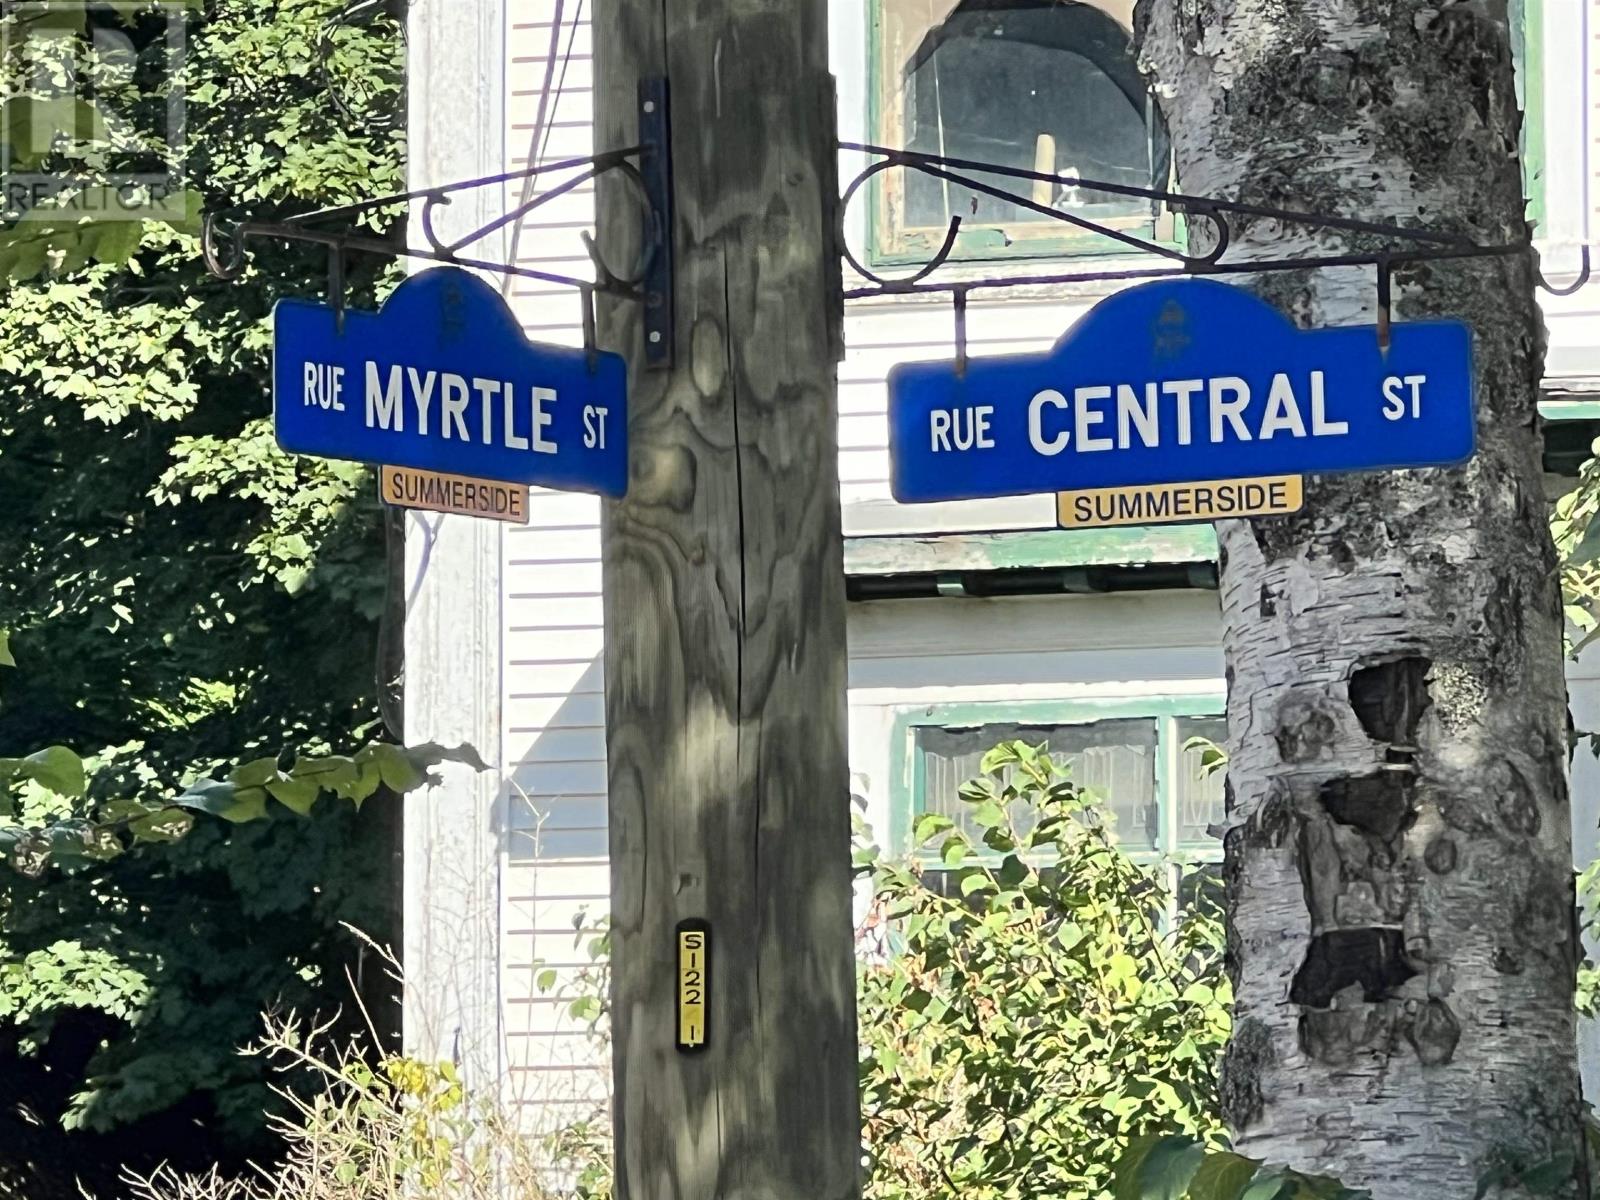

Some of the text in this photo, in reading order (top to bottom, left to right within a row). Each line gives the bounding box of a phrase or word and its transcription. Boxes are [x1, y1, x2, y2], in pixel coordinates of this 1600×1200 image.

[304, 361, 608, 454] RUE MYRTLE ST
[930, 371, 1426, 456] RUE CENTRAL ST
[391, 472, 521, 516] SUMMERSIDE
[1073, 481, 1288, 523] SUMMERSIDE
